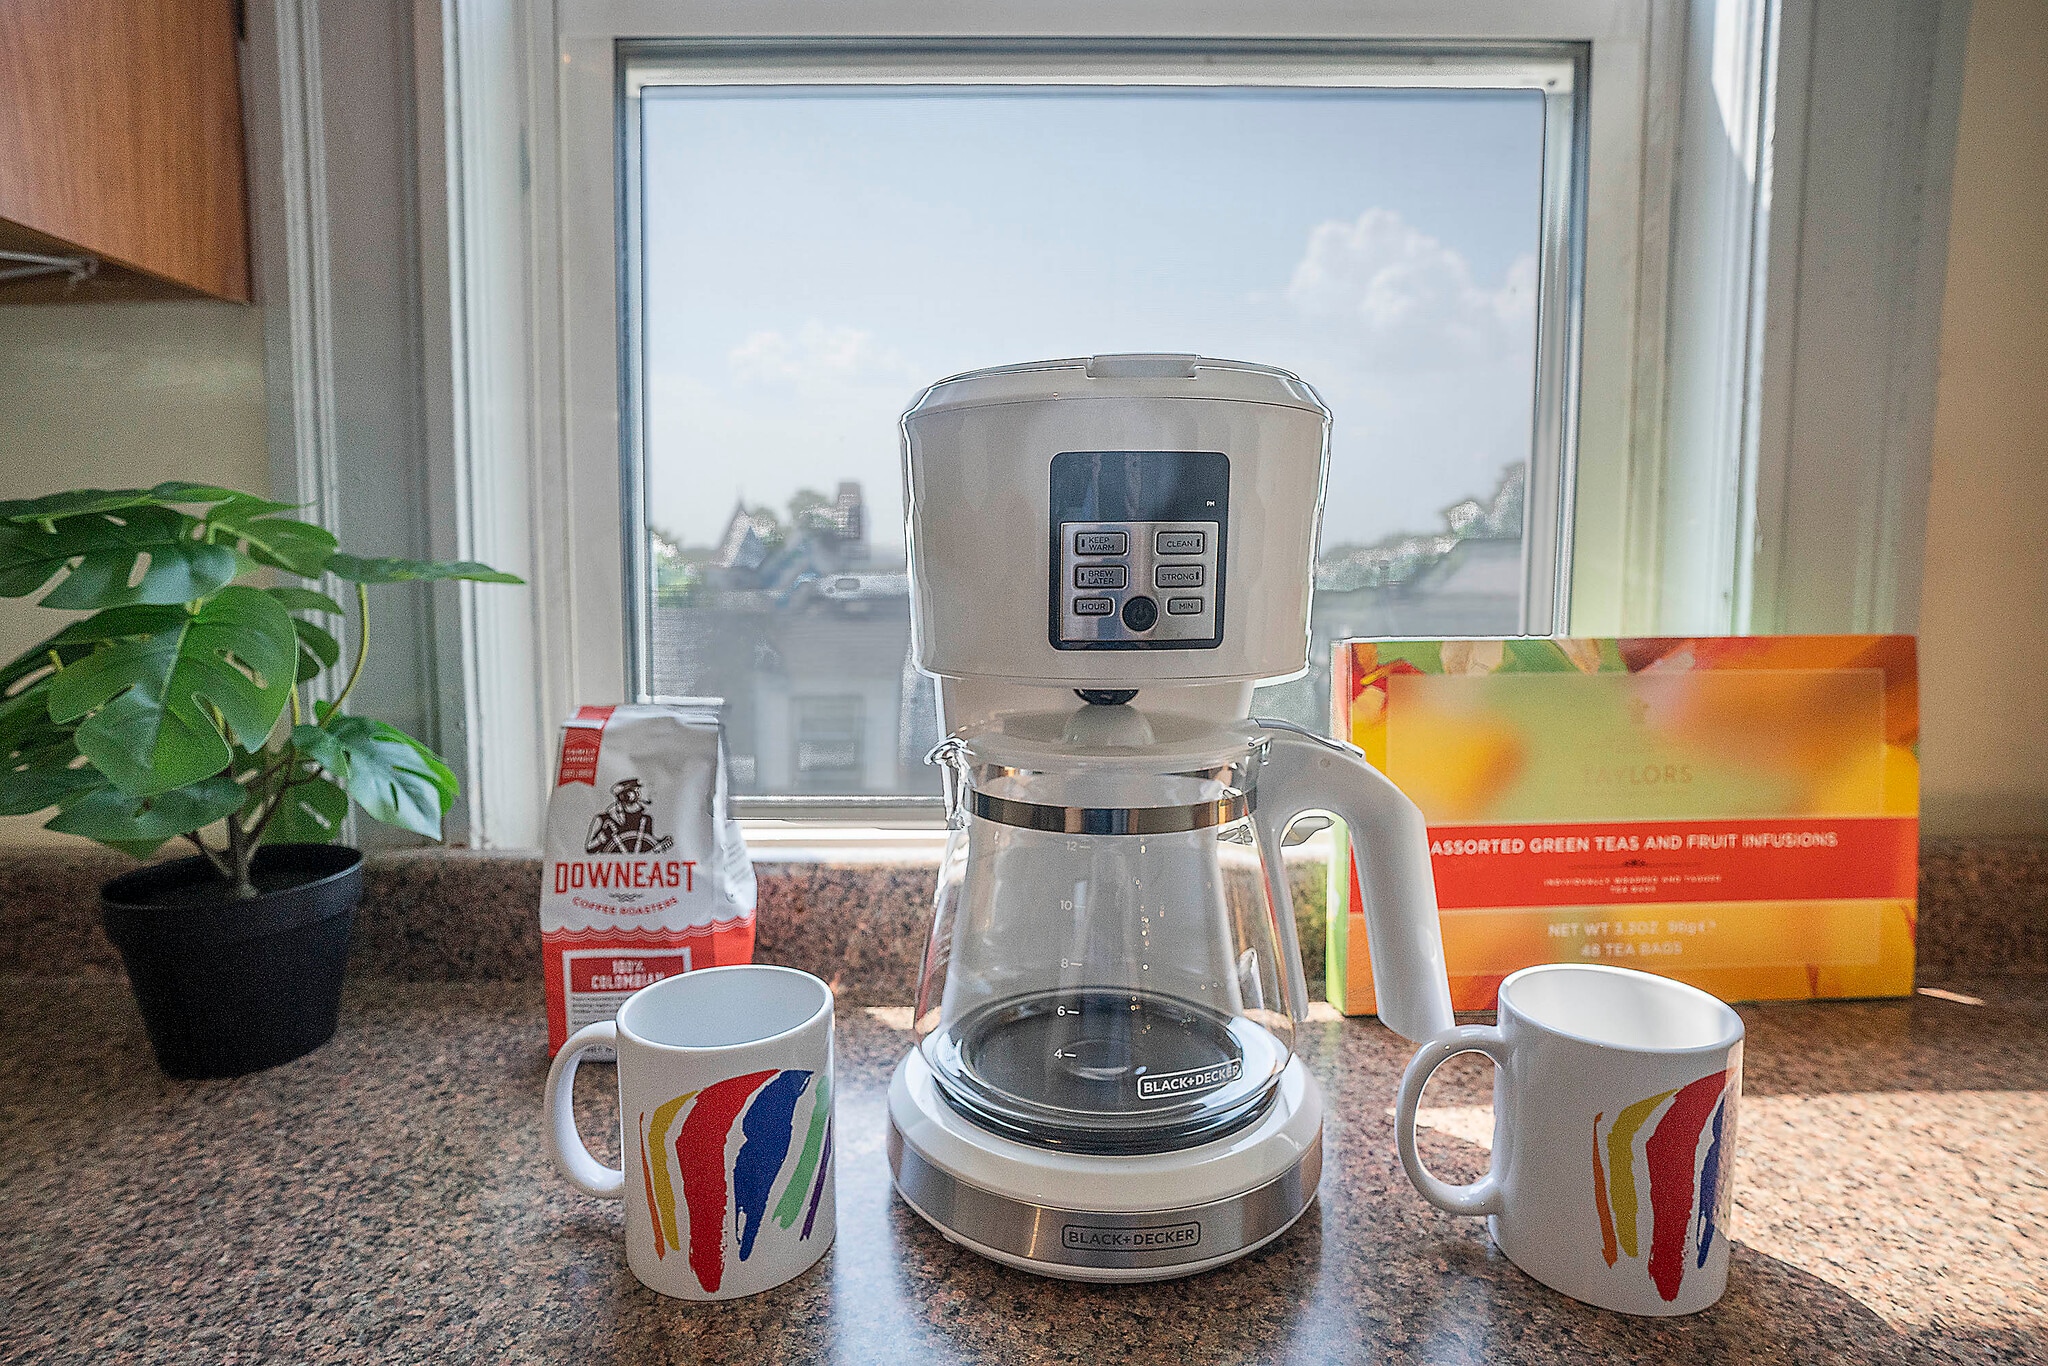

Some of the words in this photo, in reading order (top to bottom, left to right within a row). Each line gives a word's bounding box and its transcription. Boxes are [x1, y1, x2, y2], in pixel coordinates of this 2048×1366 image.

[1088, 536, 1110, 544] KEEP
[1166, 540, 1193, 548] CLEAN
[1161, 573, 1195, 581] STRONG
[1081, 603, 1106, 611] HOUR
[1178, 602, 1194, 610] MIN
[1065, 841, 1077, 851] 12
[1430, 838, 1526, 856] ASSORTED
[1529, 836, 1590, 854] GREEN
[1595, 835, 1640, 852] TEAS
[1644, 834, 1683, 851] AND
[1686, 833, 1739, 850] FRUIT
[1742, 831, 1839, 849] INFUSIONS
[554, 861, 697, 894] DOWNEAST
[572, 896, 616, 915] COFFEE
[619, 895, 678, 916] ROASTERS
[1060, 900, 1073, 911] 10
[1547, 921, 1579, 938] NET
[1583, 920, 1610, 936] WT
[1603, 941, 1636, 957] TEA
[1638, 940, 1684, 956] BAGS
[1060, 958, 1069, 969] 8
[1056, 1005, 1066, 1017] 6
[1053, 1048, 1063, 1060] 4
[1143, 1064, 1241, 1094] BLACK+DECKER
[1068, 1228, 1195, 1246] BLACK+DECKER
